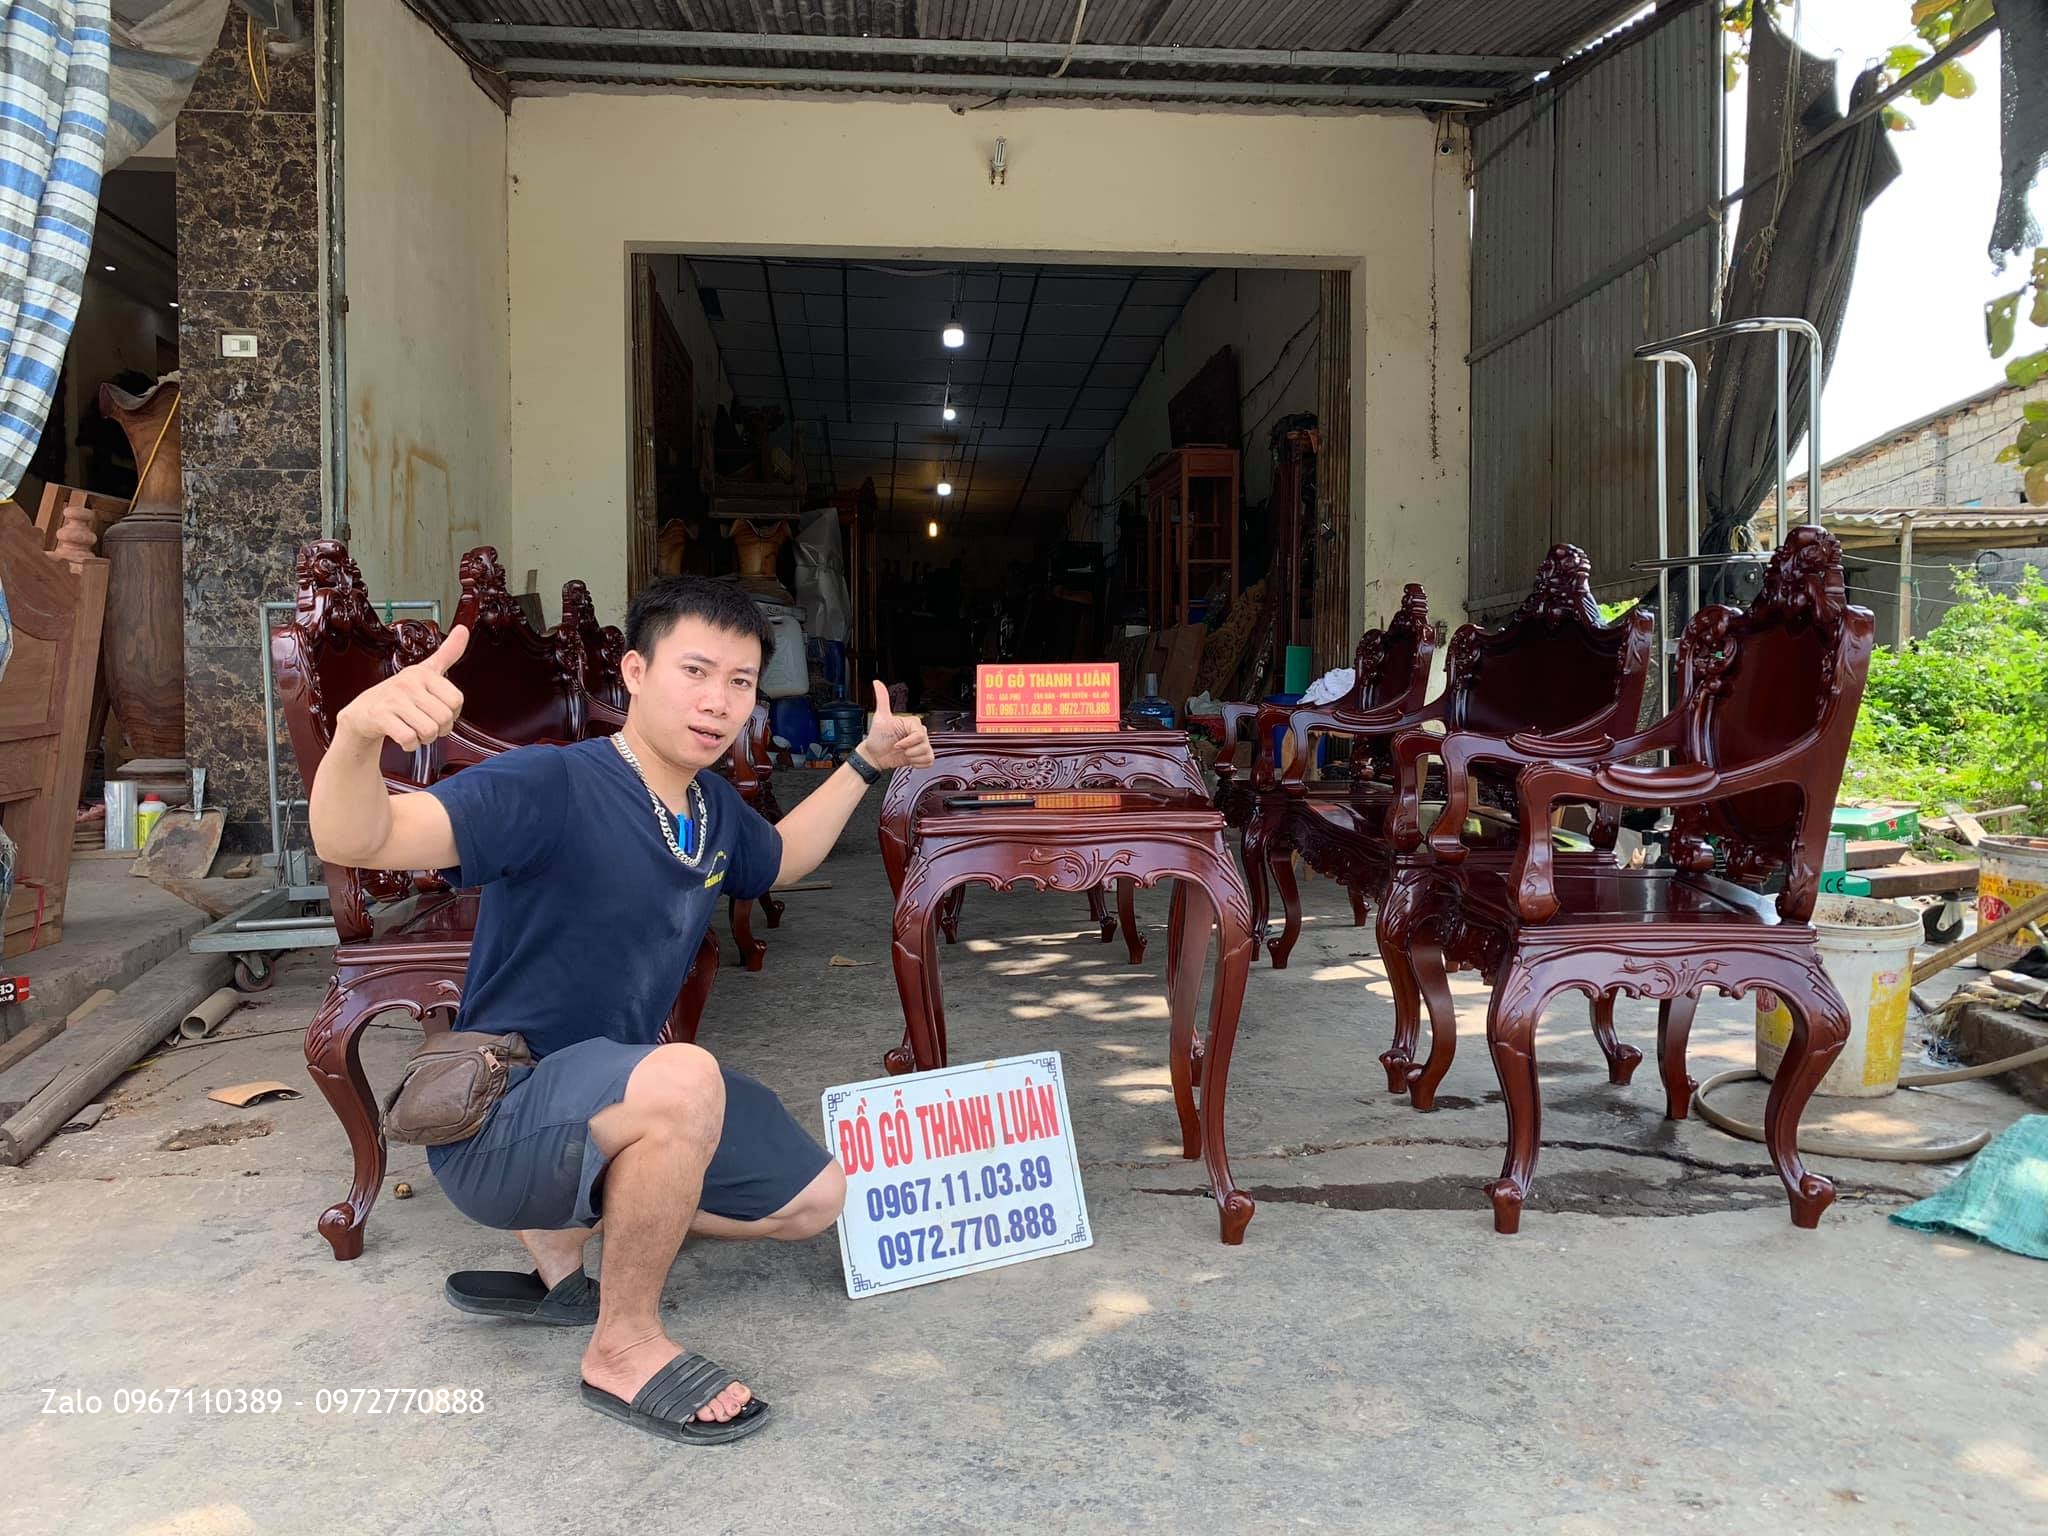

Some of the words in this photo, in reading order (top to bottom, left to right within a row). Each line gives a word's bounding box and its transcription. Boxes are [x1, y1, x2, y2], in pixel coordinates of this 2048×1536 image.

[1029, 669, 1072, 688] THÀNH
[1076, 669, 1111, 687] LUÂN
[838, 1097, 875, 1176] ĐỒ
[879, 1089, 914, 1169] GỖ
[916, 1088, 995, 1160] THÀNH
[997, 1076, 1060, 1145] LUÂN
[866, 1155, 1053, 1222] 0967.11.03.89
[878, 1203, 1057, 1270] 0972.770.888
